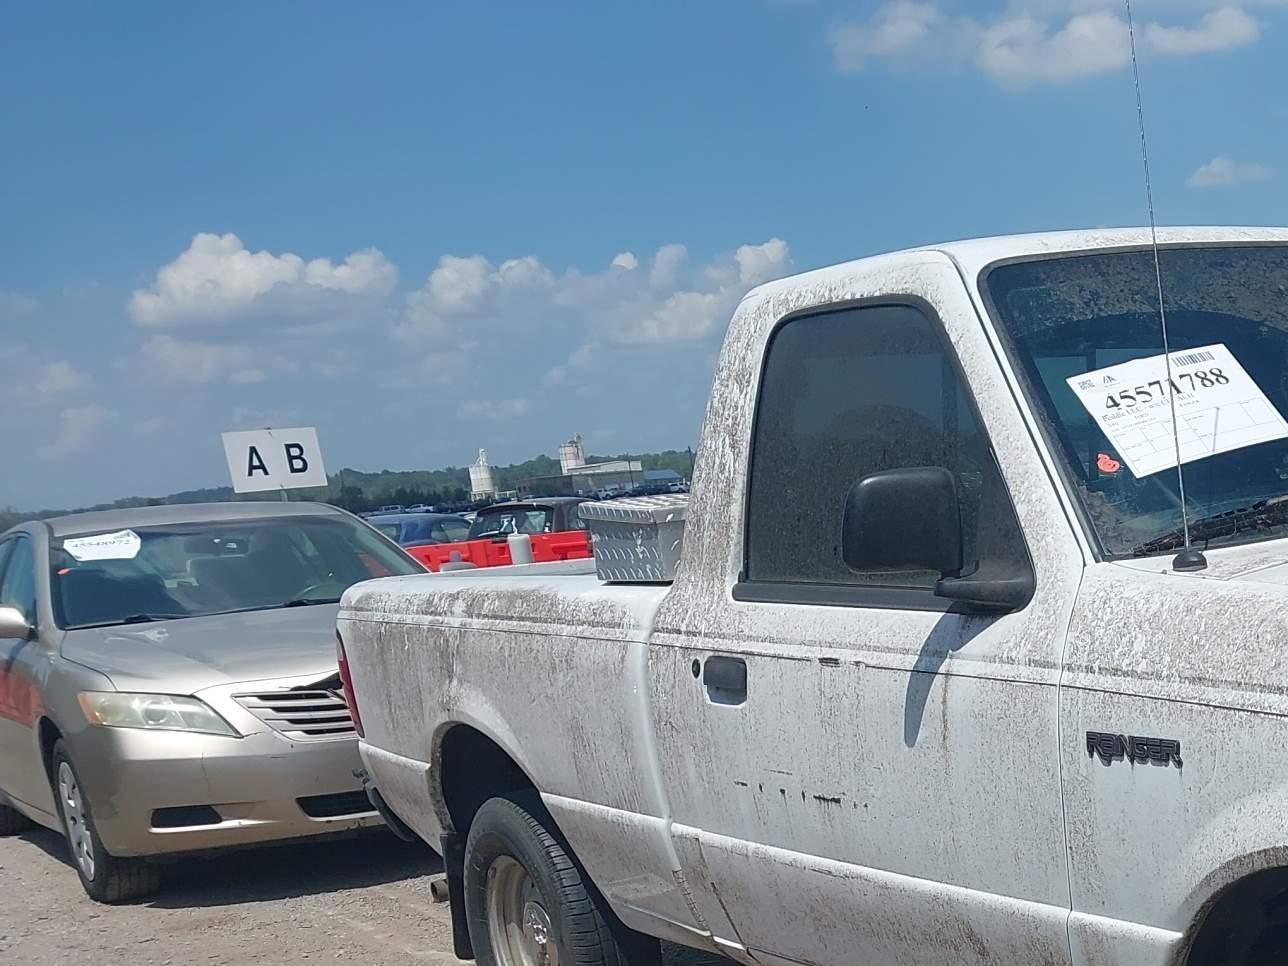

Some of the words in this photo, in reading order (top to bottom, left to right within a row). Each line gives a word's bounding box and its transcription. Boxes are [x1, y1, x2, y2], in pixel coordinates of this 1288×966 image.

[1105, 367, 1230, 410] 45571788
[247, 445, 270, 477] A
[284, 442, 308, 474] B
[1086, 731, 1183, 769] RANGER
